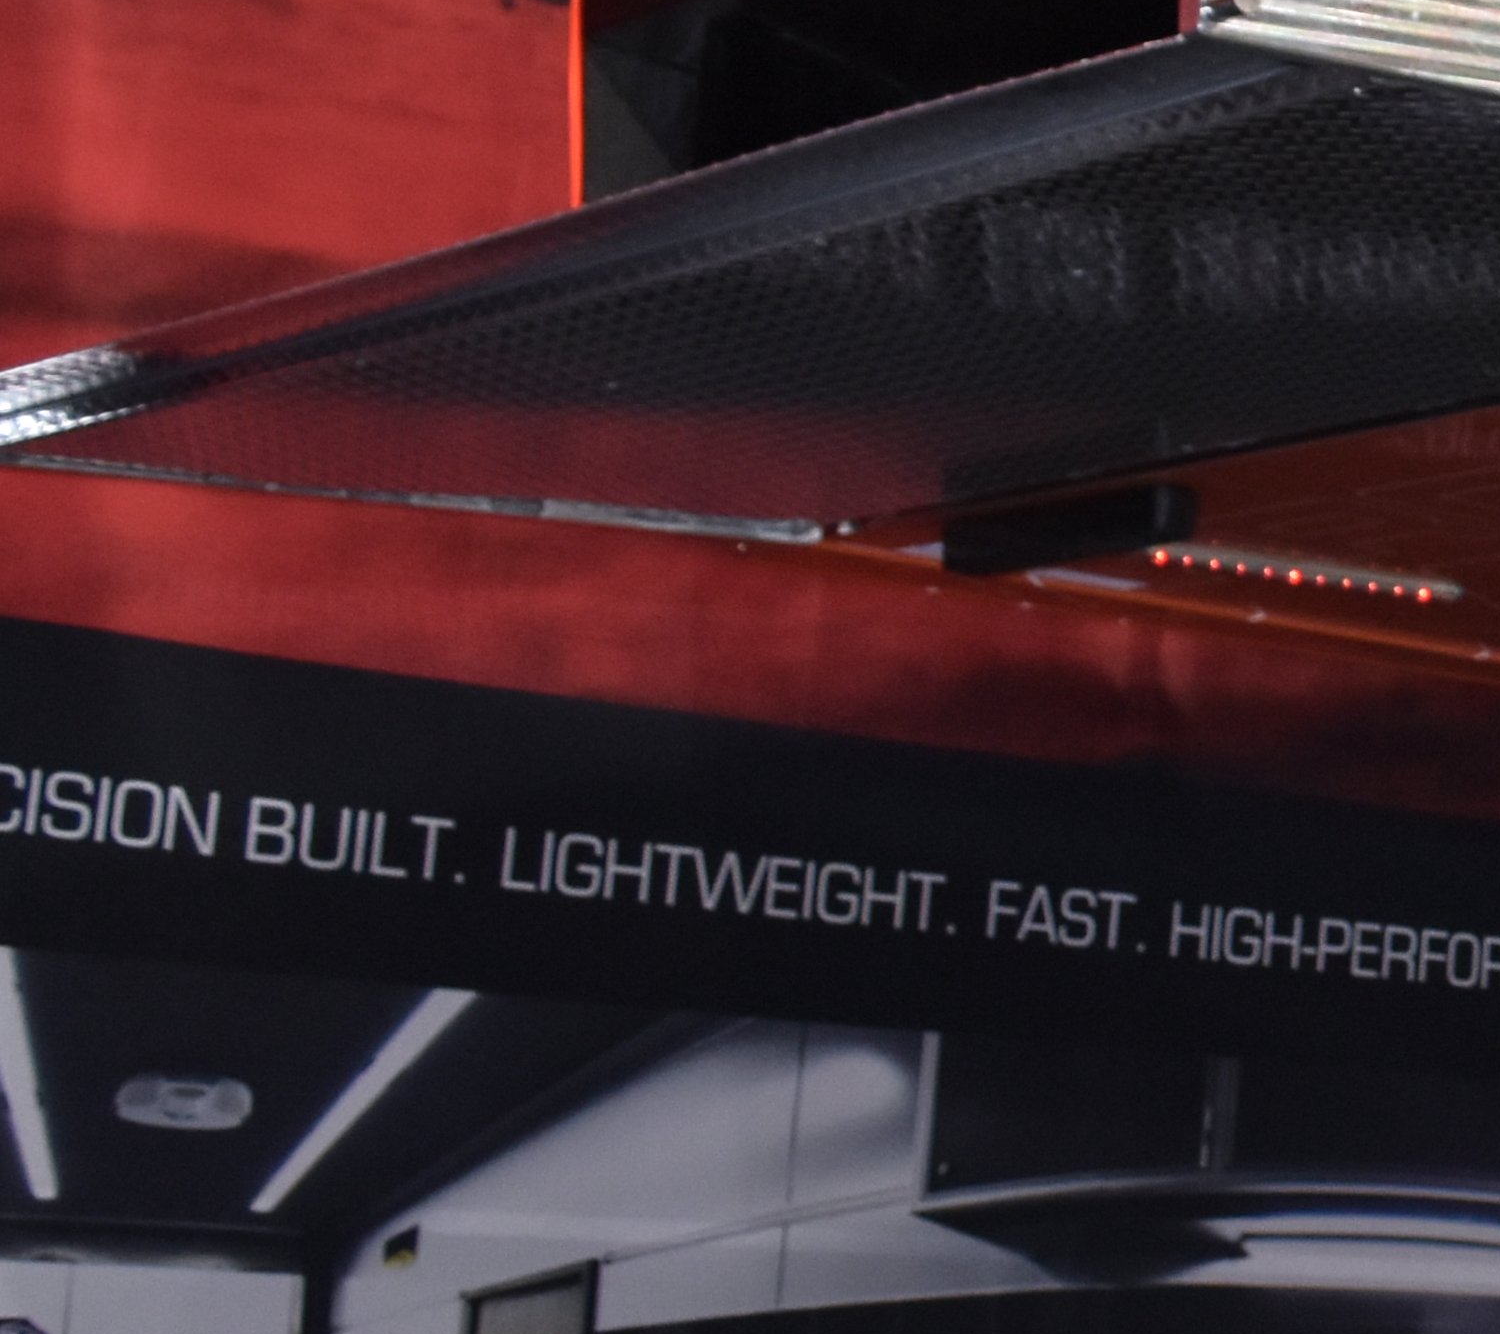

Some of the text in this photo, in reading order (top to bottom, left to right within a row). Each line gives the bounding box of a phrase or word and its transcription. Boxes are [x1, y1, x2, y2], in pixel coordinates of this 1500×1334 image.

[243, 796, 466, 883] BUILT.
[499, 826, 956, 935] LIGHTWEIGHT.
[984, 881, 1147, 953] FAST.
